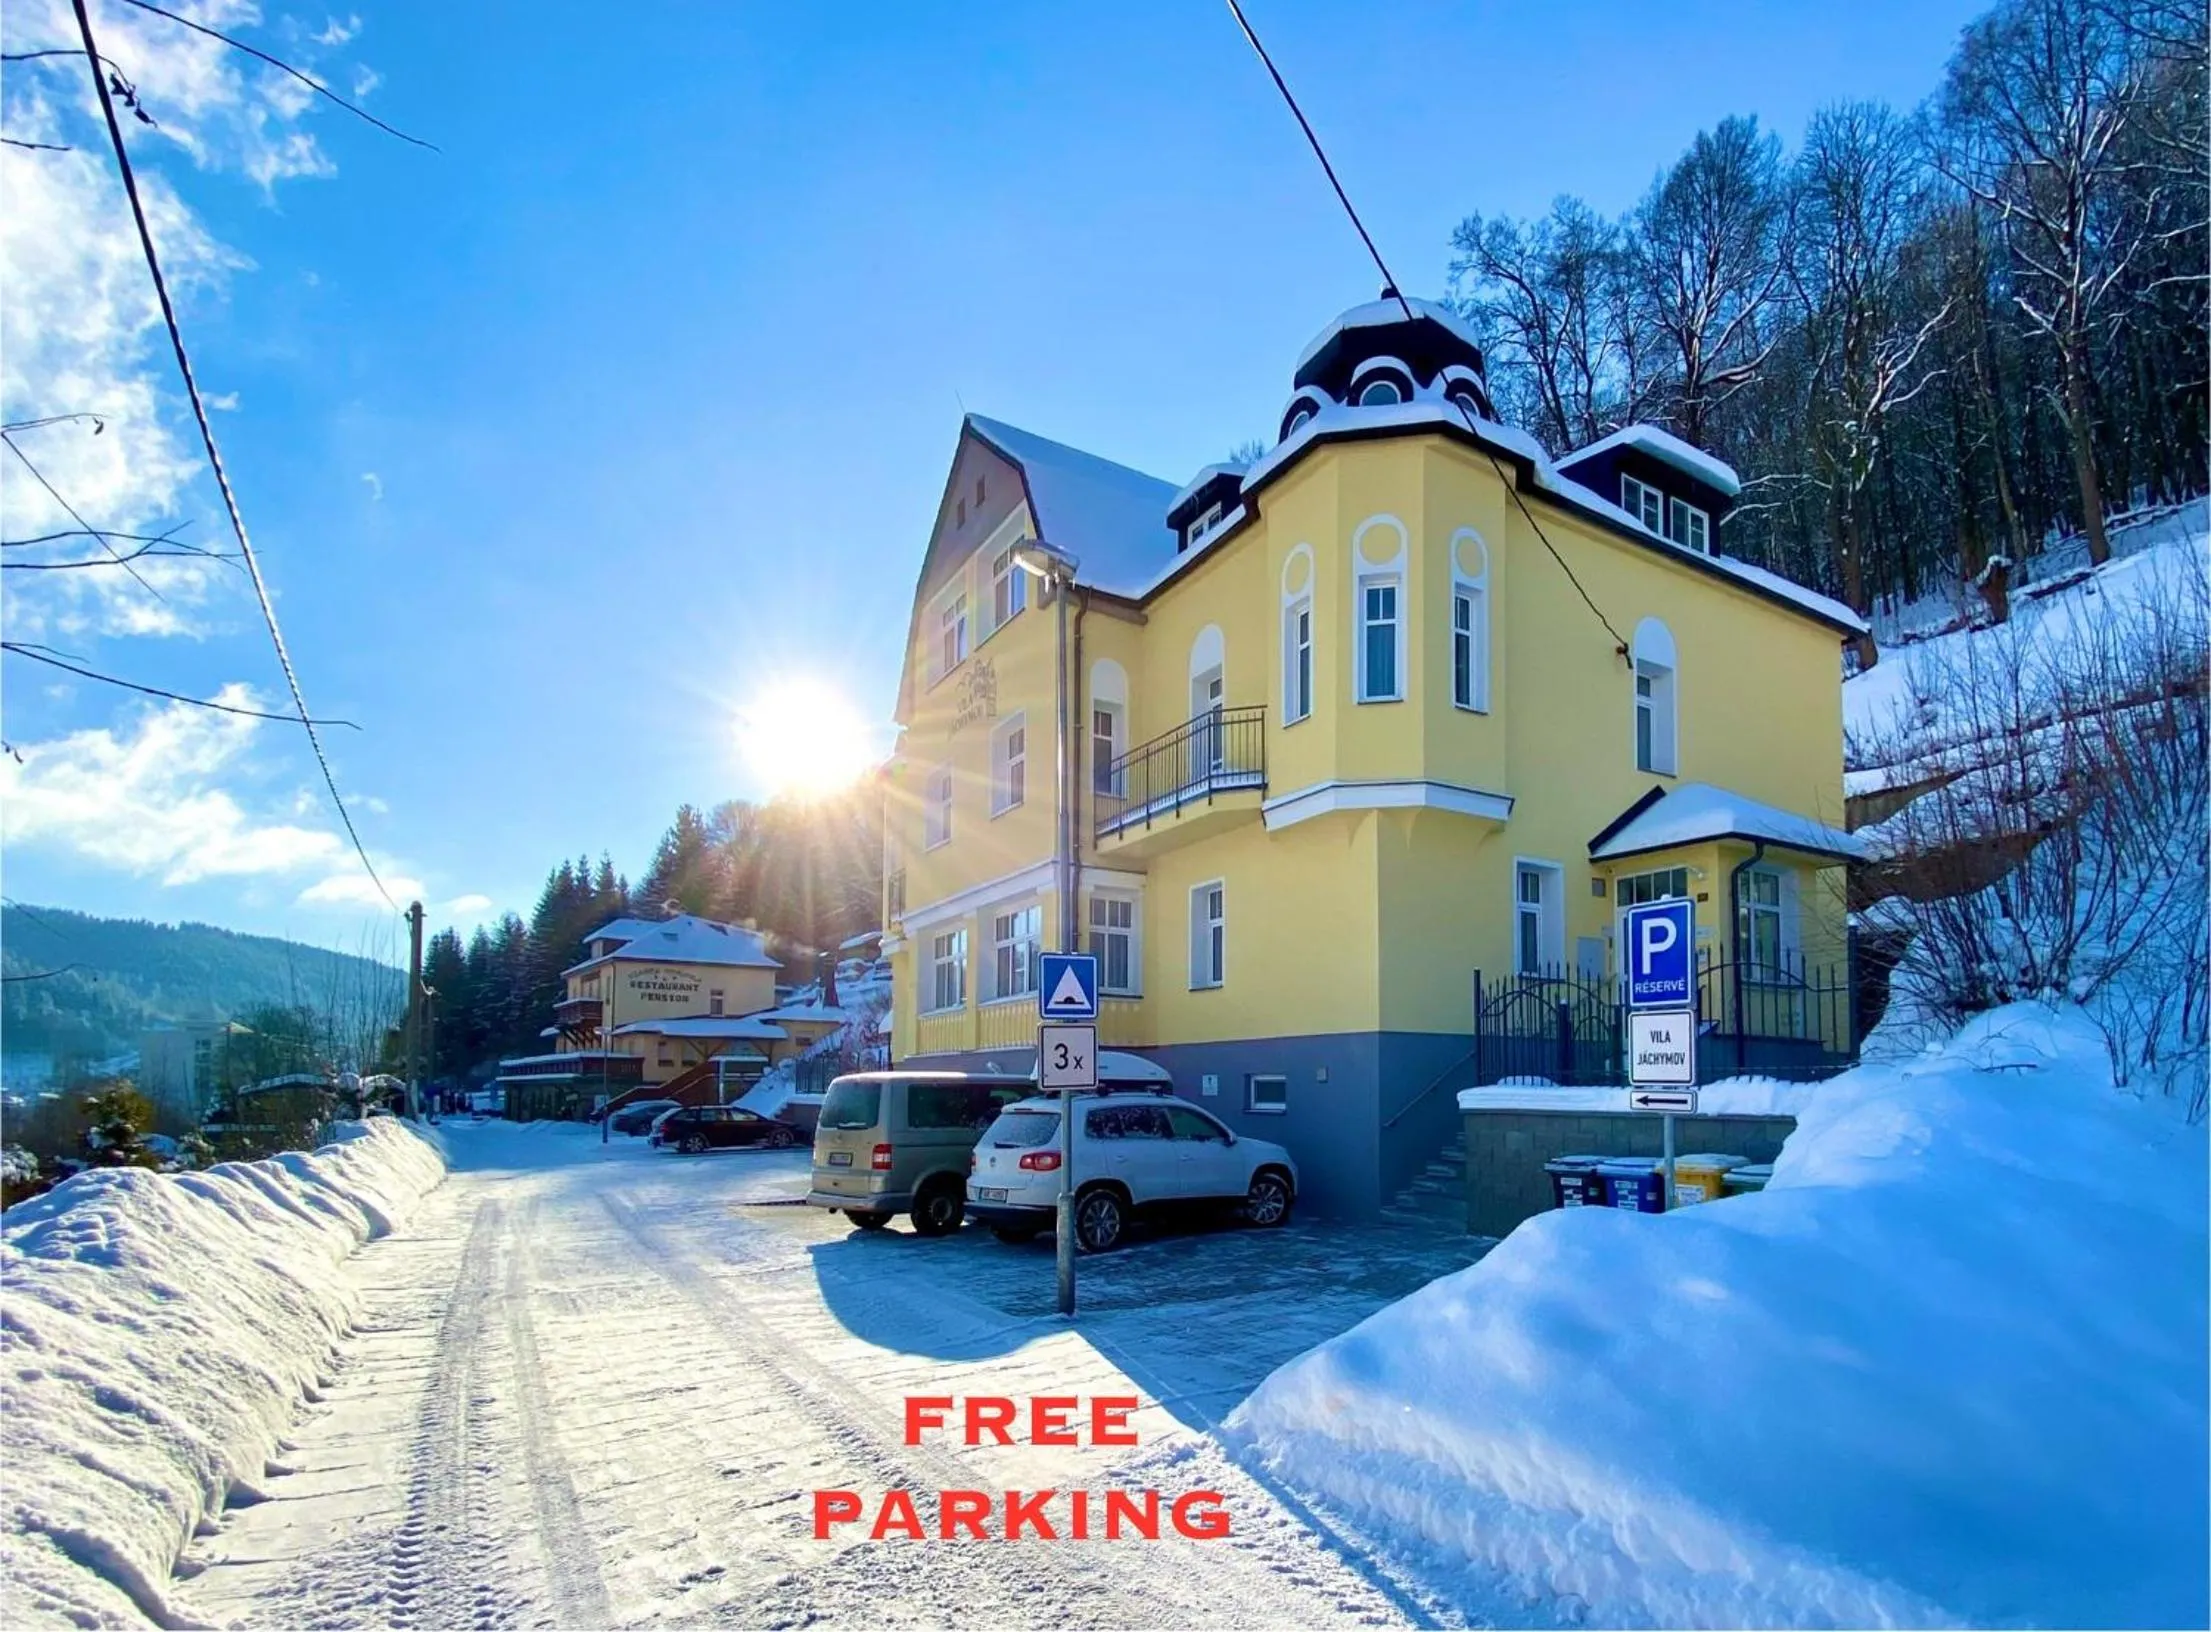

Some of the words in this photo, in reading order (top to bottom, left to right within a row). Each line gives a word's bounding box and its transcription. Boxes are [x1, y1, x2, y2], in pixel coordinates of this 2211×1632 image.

[1642, 917, 1677, 974] P
[629, 981, 700, 992] RESTAURANT
[640, 992, 690, 1003] PENSION
[1650, 1030, 1671, 1044] VILA
[1637, 1050, 1686, 1066] JÁCHYMOV
